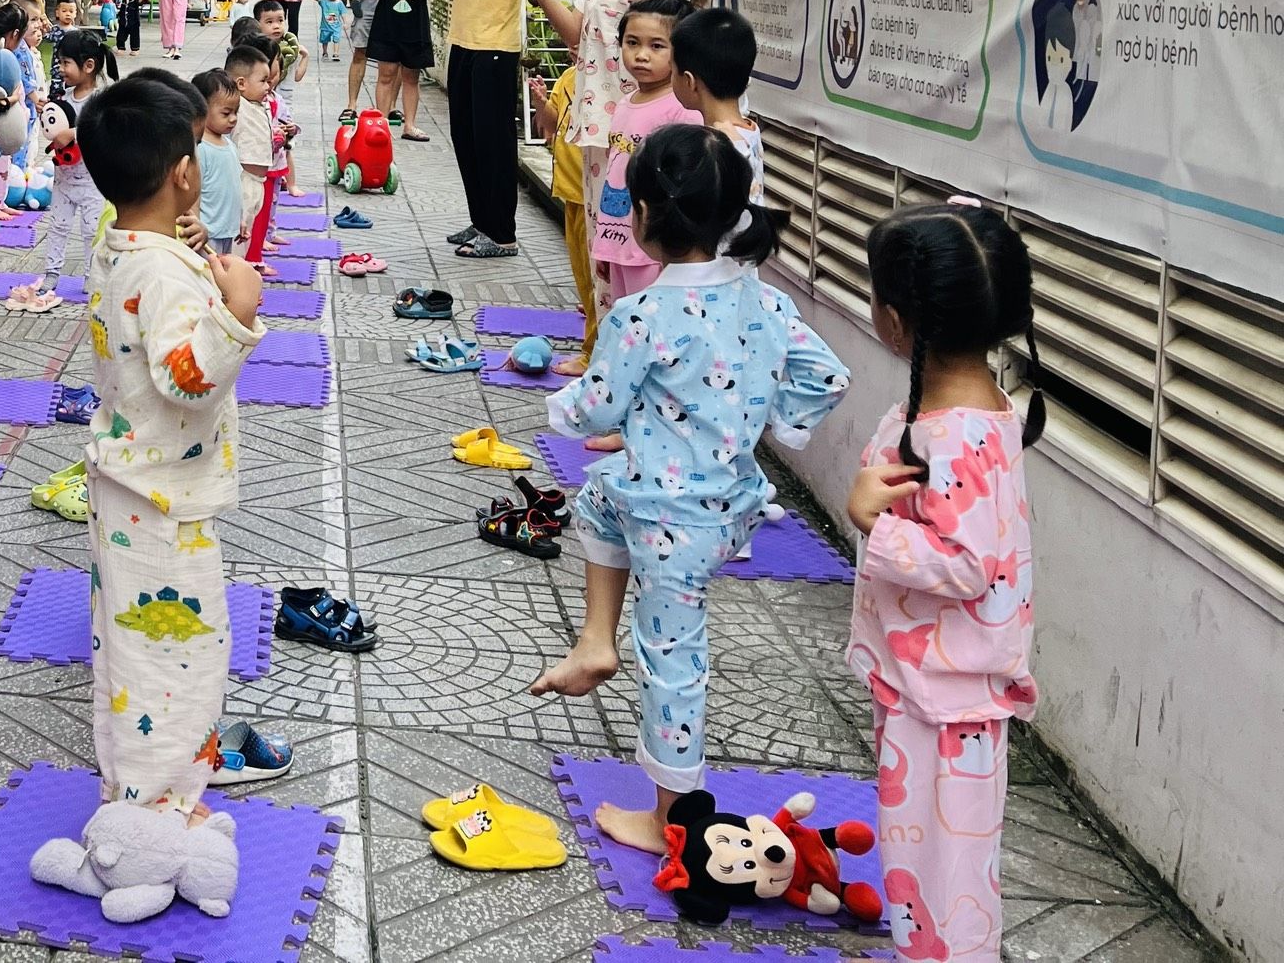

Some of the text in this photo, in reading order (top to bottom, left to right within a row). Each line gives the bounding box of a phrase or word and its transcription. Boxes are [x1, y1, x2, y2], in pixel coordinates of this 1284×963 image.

[1144, 0, 1165, 24] với
[1169, 1, 1213, 30] người
[1217, 3, 1259, 37] bệnh
[1115, 35, 1198, 70] ngờ bị bệnh
[899, 72, 913, 91] cho
[926, 82, 947, 99] quan
[948, 85, 955, 104] y
[601, 228, 628, 245] Kitty
